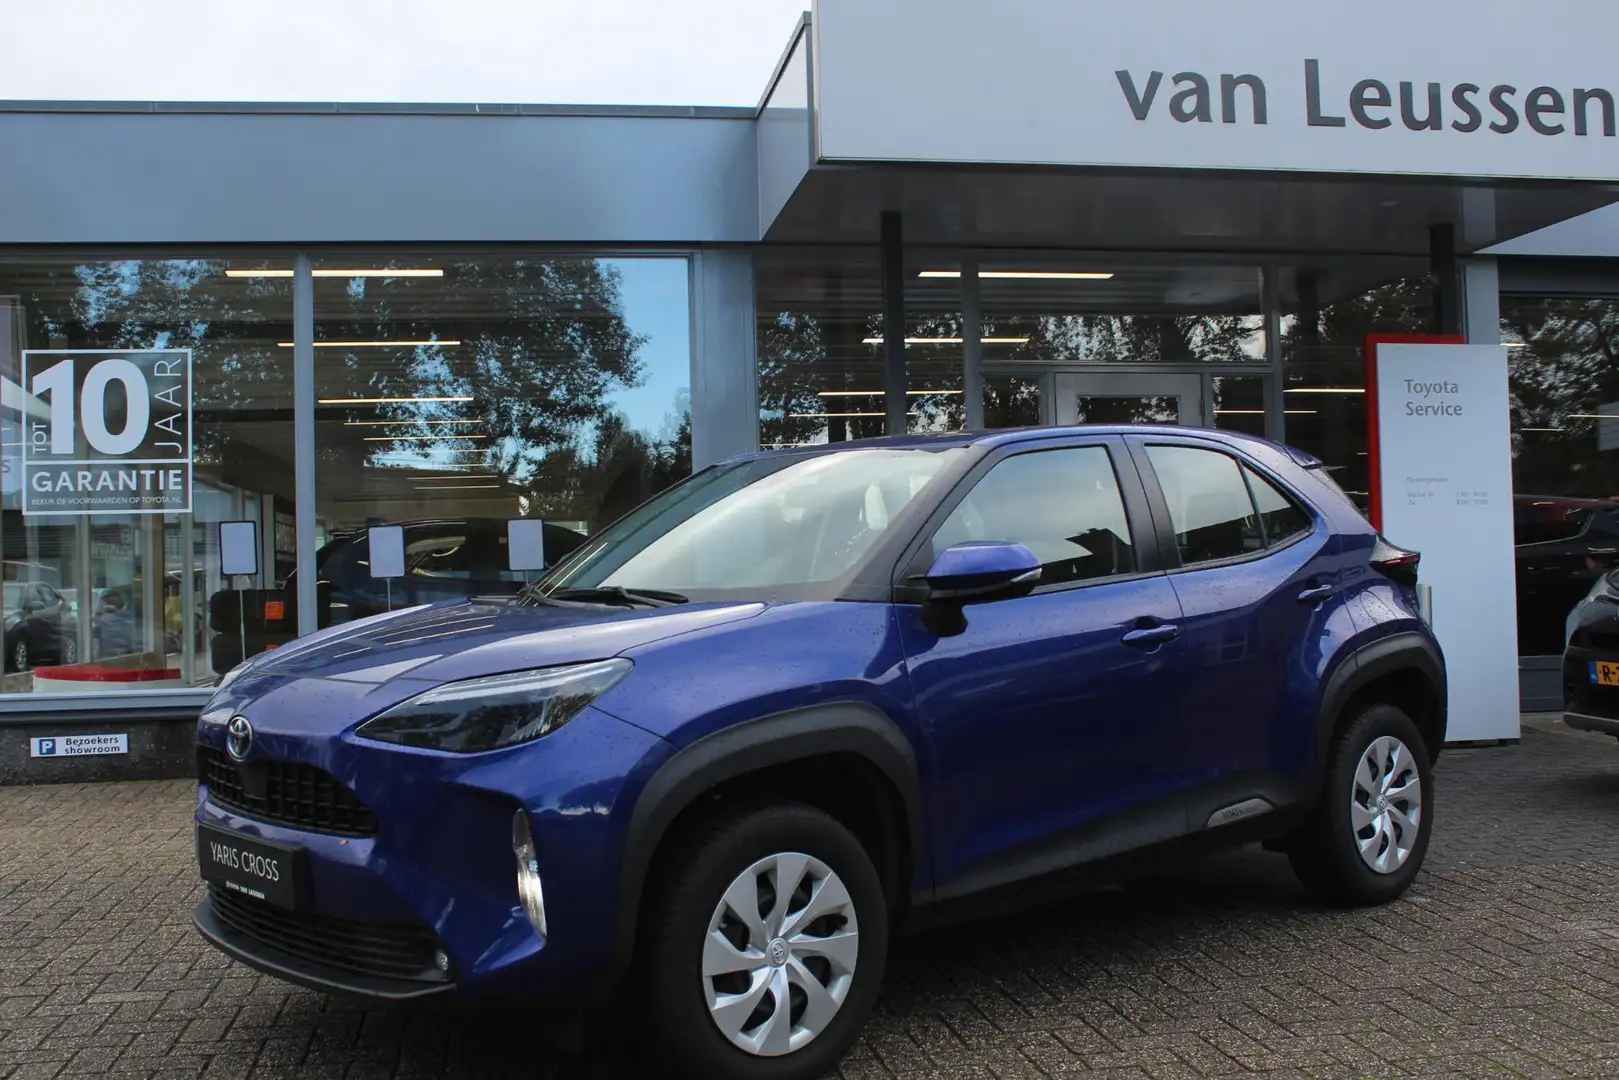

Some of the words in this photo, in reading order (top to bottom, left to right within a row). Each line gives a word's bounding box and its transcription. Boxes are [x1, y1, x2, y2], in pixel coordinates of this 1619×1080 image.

[1115, 69, 1267, 125] van
[1304, 58, 1616, 137] Leussen
[1404, 379, 1459, 398] Toyota
[32, 358, 150, 455] 10
[154, 358, 182, 454] JAAR
[1405, 401, 1463, 416] Service
[32, 422, 47, 455] TOT
[32, 469, 182, 492] GARANTIE
[56, 498, 67, 506] DE
[68, 496, 127, 505] VOORWAARDEN
[128, 496, 140, 504] OP
[141, 495, 183, 504] TOYOTA.NL
[41, 740, 53, 754] P
[64, 745, 120, 754] showroom
[66, 737, 119, 746] Bezoekers
[210, 841, 239, 869] YARIS
[241, 851, 279, 882] CROSS
